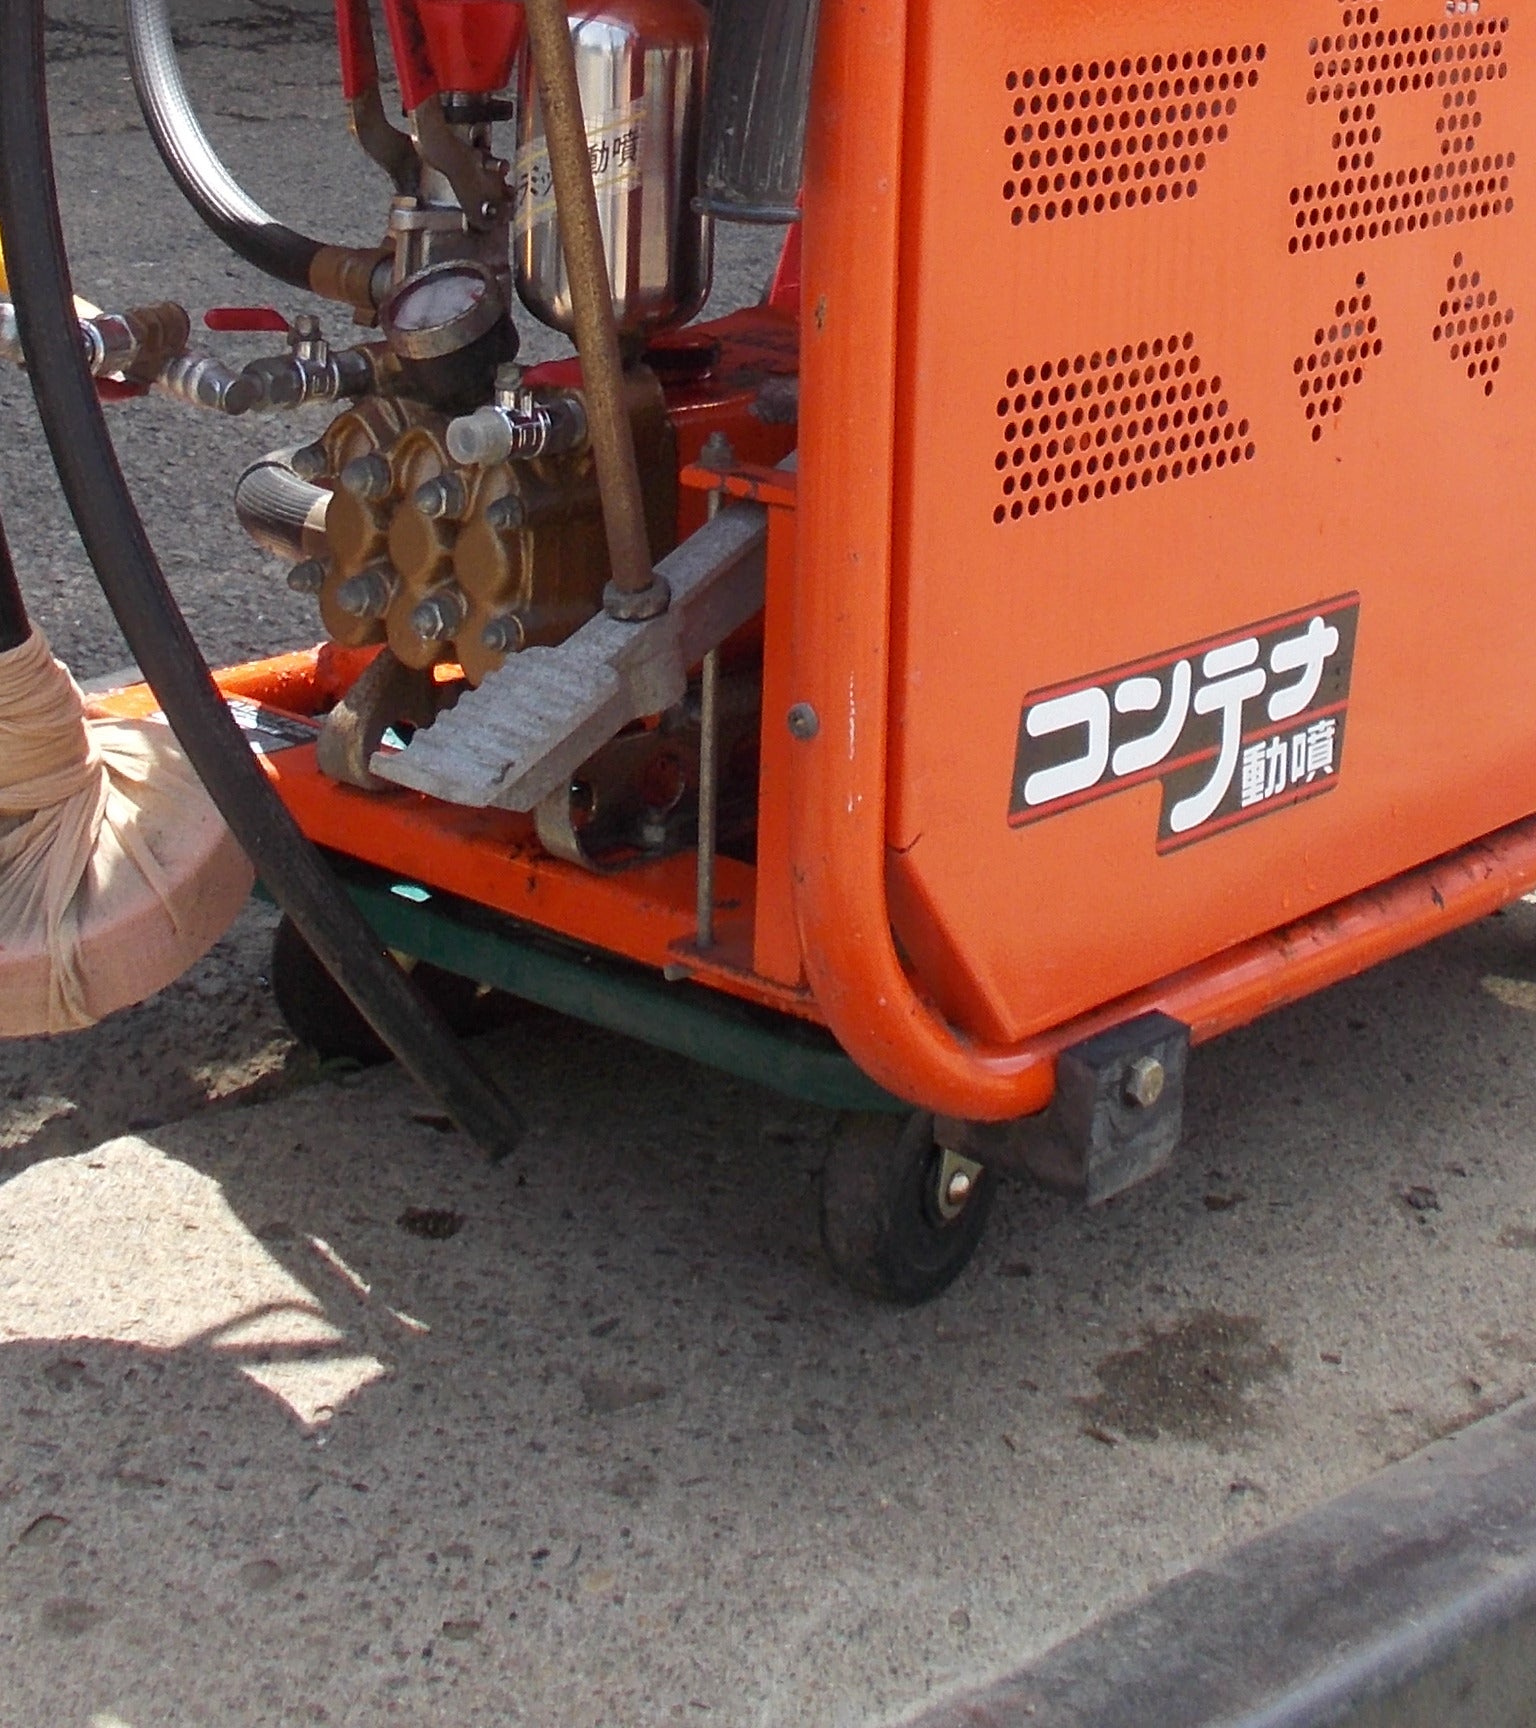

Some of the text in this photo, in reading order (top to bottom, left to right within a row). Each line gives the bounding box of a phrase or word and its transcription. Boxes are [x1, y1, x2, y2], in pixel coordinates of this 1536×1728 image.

[1024, 615, 1340, 833] コンテナ
[1240, 718, 1337, 809] 動噴
